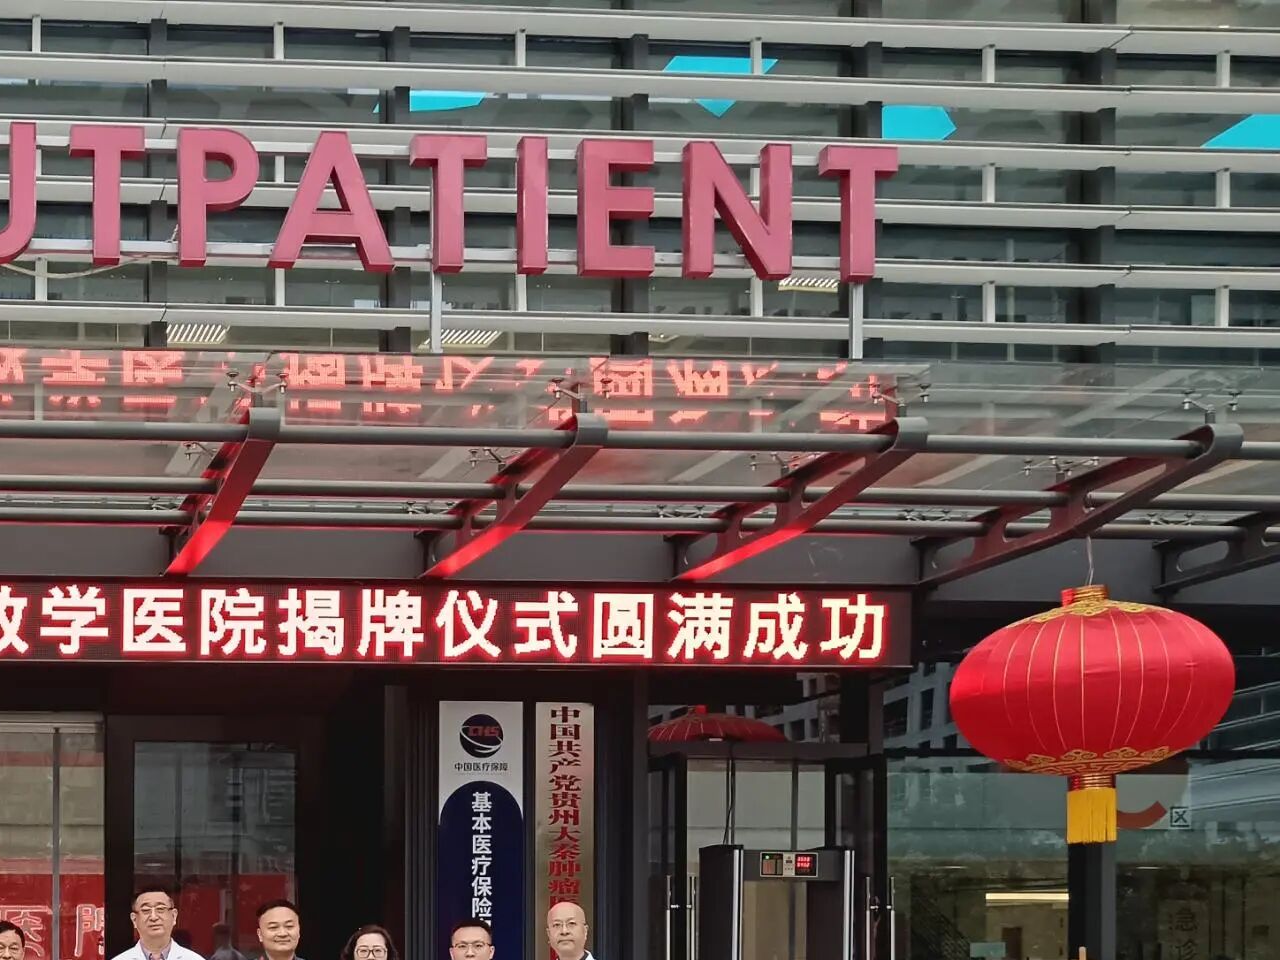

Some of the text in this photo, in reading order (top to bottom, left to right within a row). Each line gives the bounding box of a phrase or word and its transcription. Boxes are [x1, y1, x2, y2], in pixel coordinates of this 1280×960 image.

[454, 762, 509, 772] 中国医疗保障
[471, 791, 493, 927] 基本医疗保险
